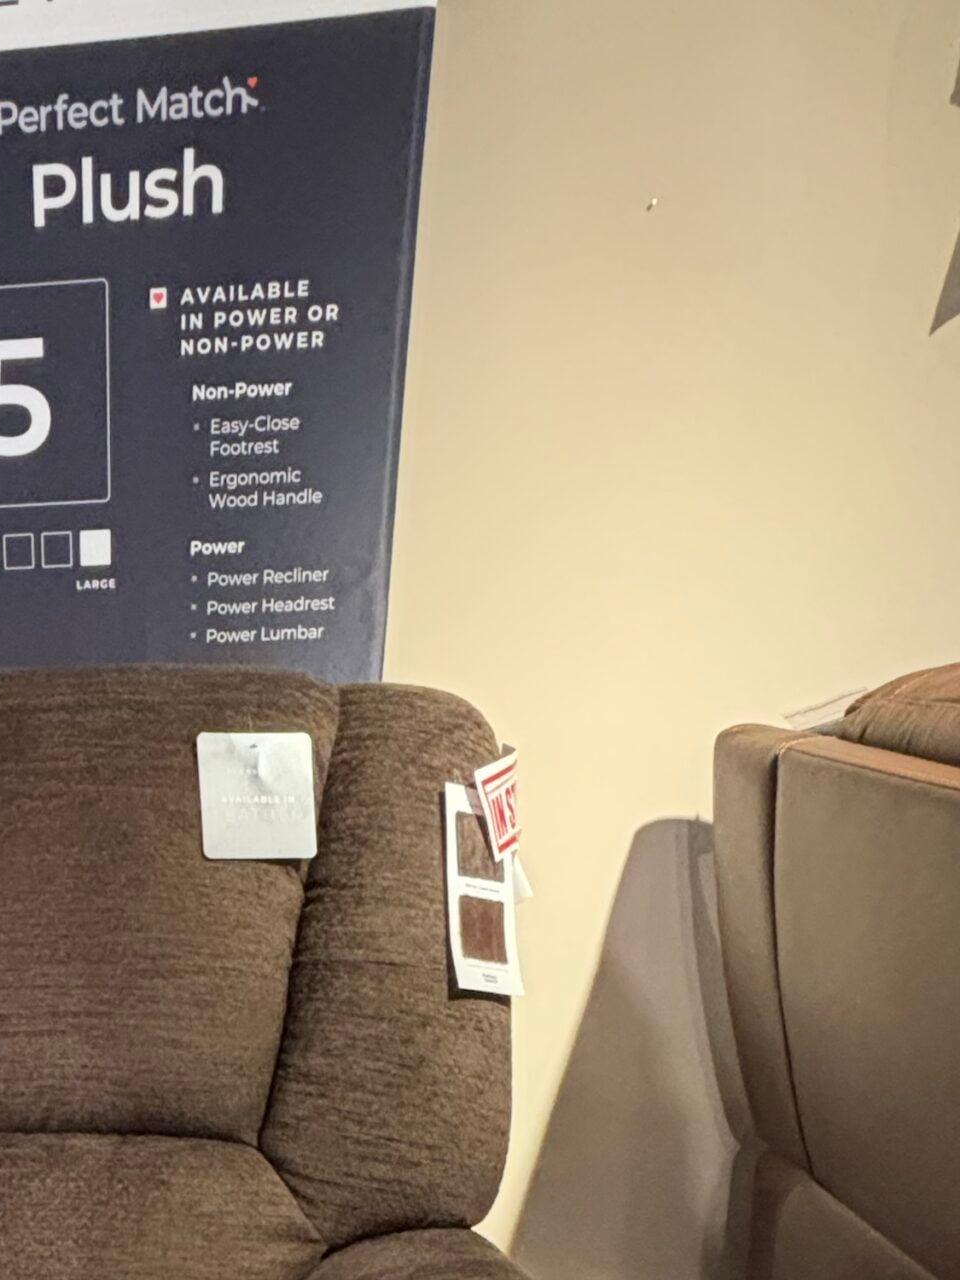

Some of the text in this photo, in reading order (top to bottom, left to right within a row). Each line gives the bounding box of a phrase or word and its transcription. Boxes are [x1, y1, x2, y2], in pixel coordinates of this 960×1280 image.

[136, 75, 259, 125] Match
[32, 147, 225, 229] Plush
[180, 279, 310, 306] AVAILABLE
[180, 304, 340, 330] IN POWER OR
[180, 331, 325, 356] NON-POWER
[192, 382, 293, 401] Non-Power
[210, 415, 301, 436] Easy-Close
[210, 439, 280, 457] Footrest
[209, 466, 302, 490] Ergonomic
[208, 488, 323, 509] Wood Handle
[190, 540, 246, 556] Power
[76, 578, 116, 591] LARGE
[207, 567, 330, 587] Power Recliner
[206, 596, 336, 616] Power Headrest
[206, 624, 325, 644] Power Lumbar
